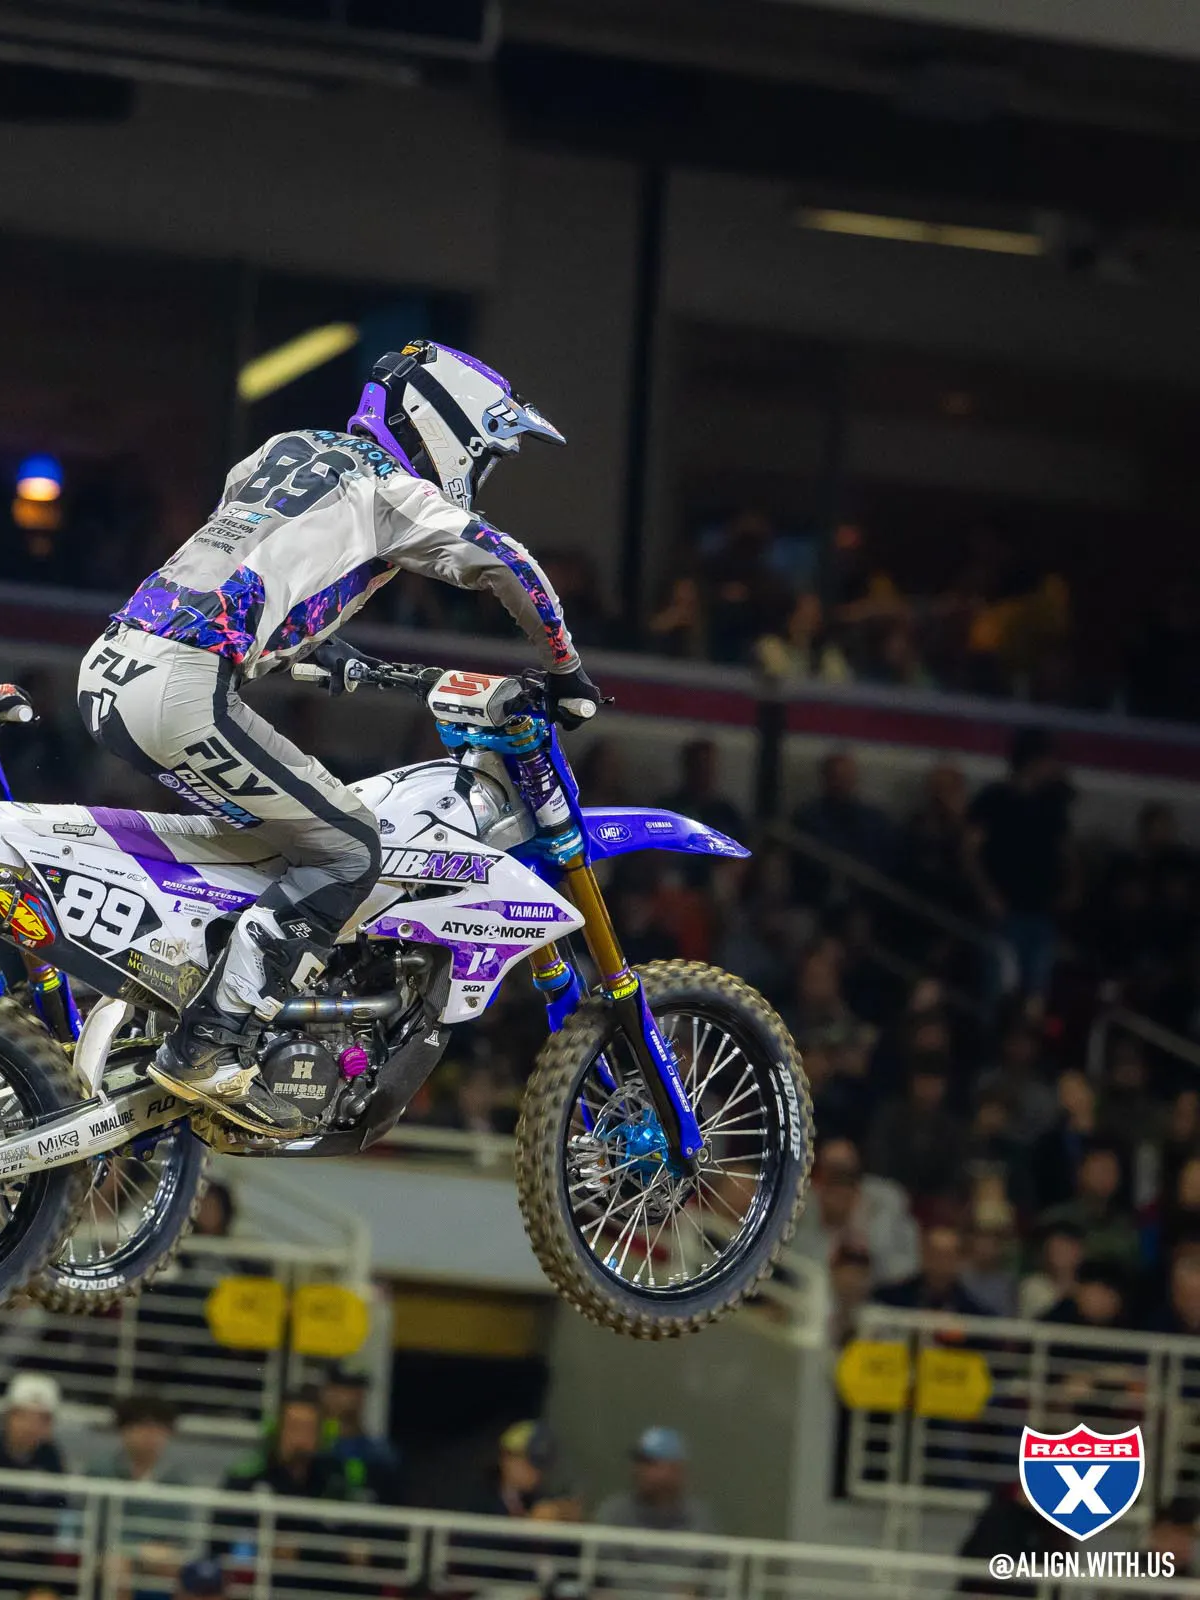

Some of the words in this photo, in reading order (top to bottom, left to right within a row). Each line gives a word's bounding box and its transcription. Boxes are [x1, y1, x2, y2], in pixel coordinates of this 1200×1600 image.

[233, 434, 358, 519] 89
[89, 647, 157, 687] FLY
[184, 736, 278, 797] FLY
[174, 768, 265, 826] CLUBMX
[381, 849, 505, 884] UBMX
[162, 880, 205, 895] PAULSON
[207, 891, 246, 903] STUSSY
[57, 874, 146, 949] 89
[509, 905, 554, 919] YAMAHA
[440, 921, 547, 939] ATVS&MORE
[461, 984, 486, 993] SKDA
[291, 1060, 315, 1080] H
[273, 1082, 328, 1095] HINSON
[88, 1108, 136, 1138] YAMALUBE
[778, 1068, 801, 1161] DUNLOP
[37, 1129, 80, 1156] Mika
